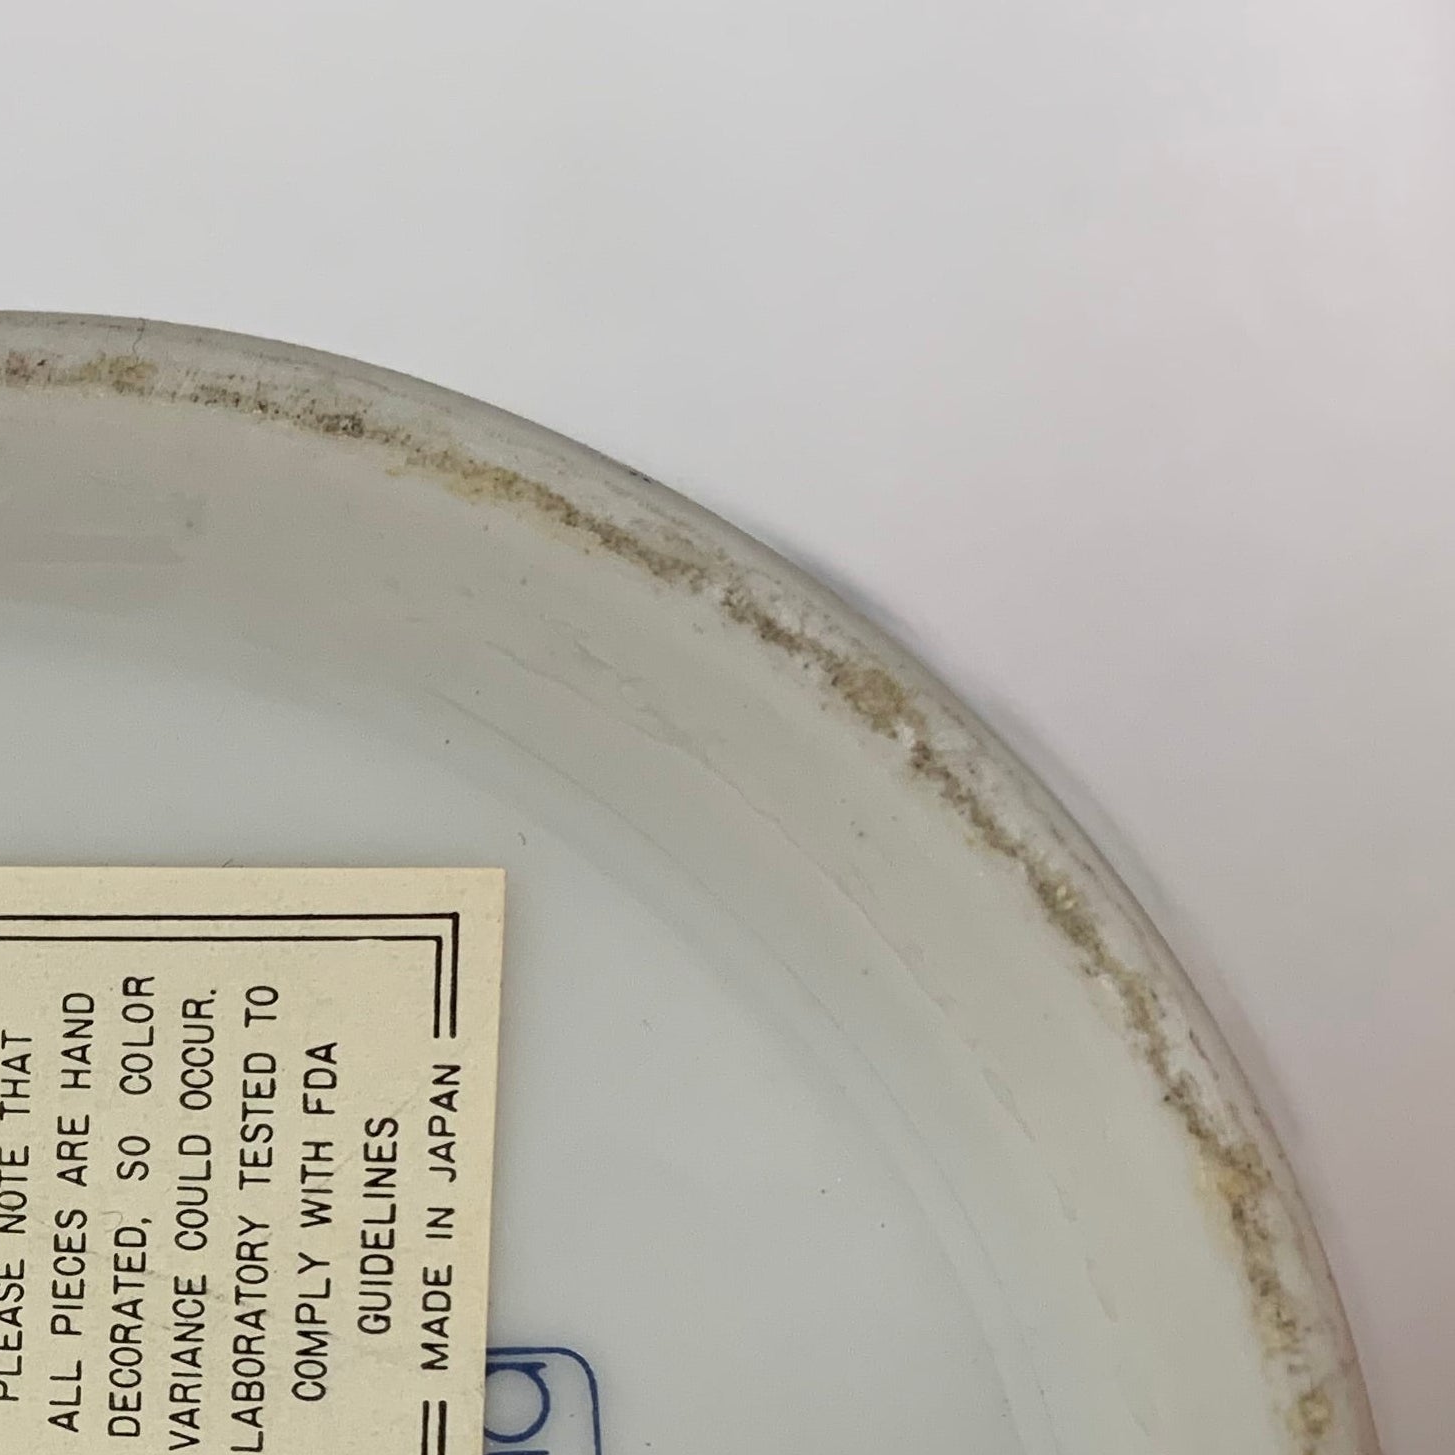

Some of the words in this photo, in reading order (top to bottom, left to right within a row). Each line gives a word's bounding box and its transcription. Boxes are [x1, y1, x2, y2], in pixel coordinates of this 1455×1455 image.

[60, 992, 95, 1089] HAND
[118, 976, 155, 1096] COLOR
[179, 989, 217, 1111] OCCUR.
[244, 985, 279, 1029] TO
[238, 1052, 277, 1191] TESTED
[302, 1042, 338, 1115] FDA
[427, 1064, 462, 1183] JAPAN
[56, 1114, 90, 1187] ARE
[116, 1135, 151, 1182] SO
[174, 1134, 212, 1251] COULD
[299, 1141, 335, 1228] WITH
[50, 1209, 88, 1336] PIECES
[357, 1117, 399, 1335] GUIDELINES
[425, 1207, 455, 1240] IN
[107, 1217, 153, 1438] DECORATED,
[168, 1274, 208, 1451] VARIANCE
[230, 1215, 270, 1453] LABORATORY
[291, 1251, 332, 1402] COMPLY
[420, 1264, 453, 1371] MADE
[47, 1359, 82, 1433] ALL
